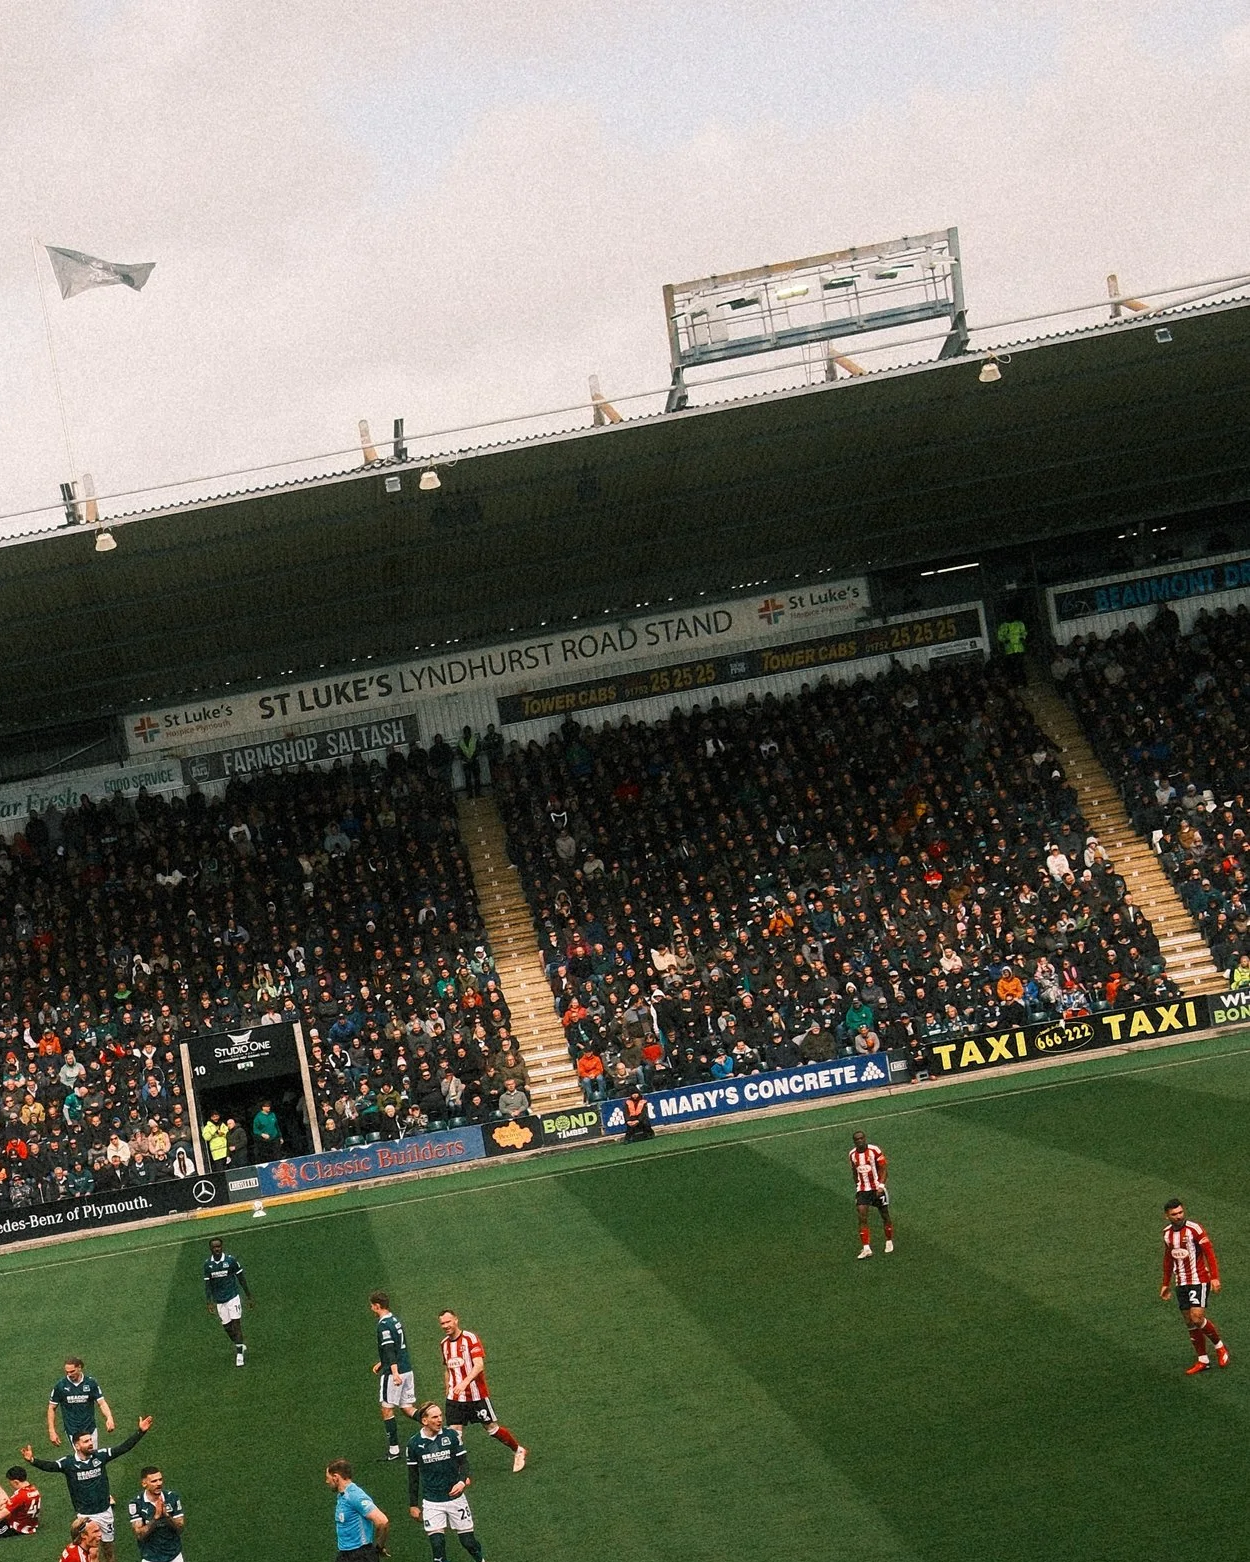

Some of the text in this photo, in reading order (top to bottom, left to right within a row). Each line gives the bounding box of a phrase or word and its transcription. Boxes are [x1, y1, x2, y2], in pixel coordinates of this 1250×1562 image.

[789, 586, 860, 611] St Luke's
[1095, 567, 1217, 612] BEAUMONT
[761, 649, 815, 673] TOWER
[817, 639, 858, 661] CABS
[890, 628, 911, 649] 25
[913, 623, 934, 644] 25
[937, 617, 958, 639] 25
[258, 609, 734, 720] ST LUKE'S LYNDHURST ROAD STAND
[522, 690, 577, 717] TOWER
[577, 684, 618, 707] CABS
[650, 671, 671, 693] 25
[672, 667, 694, 689] 25
[695, 662, 717, 685] 25
[164, 704, 233, 729] St Luke's
[223, 736, 319, 776] FARMSHOP
[325, 720, 407, 757] SALTASH
[132, 769, 175, 790] SERVICE
[25, 788, 79, 814] Fresh
[1102, 1001, 1198, 1042] TAXI
[214, 1045, 249, 1058] STUDIO
[249, 1041, 272, 1052] ONE
[933, 1023, 1092, 1071] TAXI 666-222
[193, 1065, 206, 1076] 10
[661, 1087, 739, 1120] MARY'S
[744, 1066, 858, 1101] CONCRETE
[543, 1111, 598, 1134] BOND
[557, 1127, 589, 1139] TIMBER
[299, 1137, 467, 1184] Classic Builders
[66, 1206, 80, 1222] of
[82, 1196, 153, 1220] Plymouth.
[421, 1449, 450, 1460] BEACON
[423, 1454, 451, 1464] ELECTRICAL
[76, 1467, 101, 1477] BEACON
